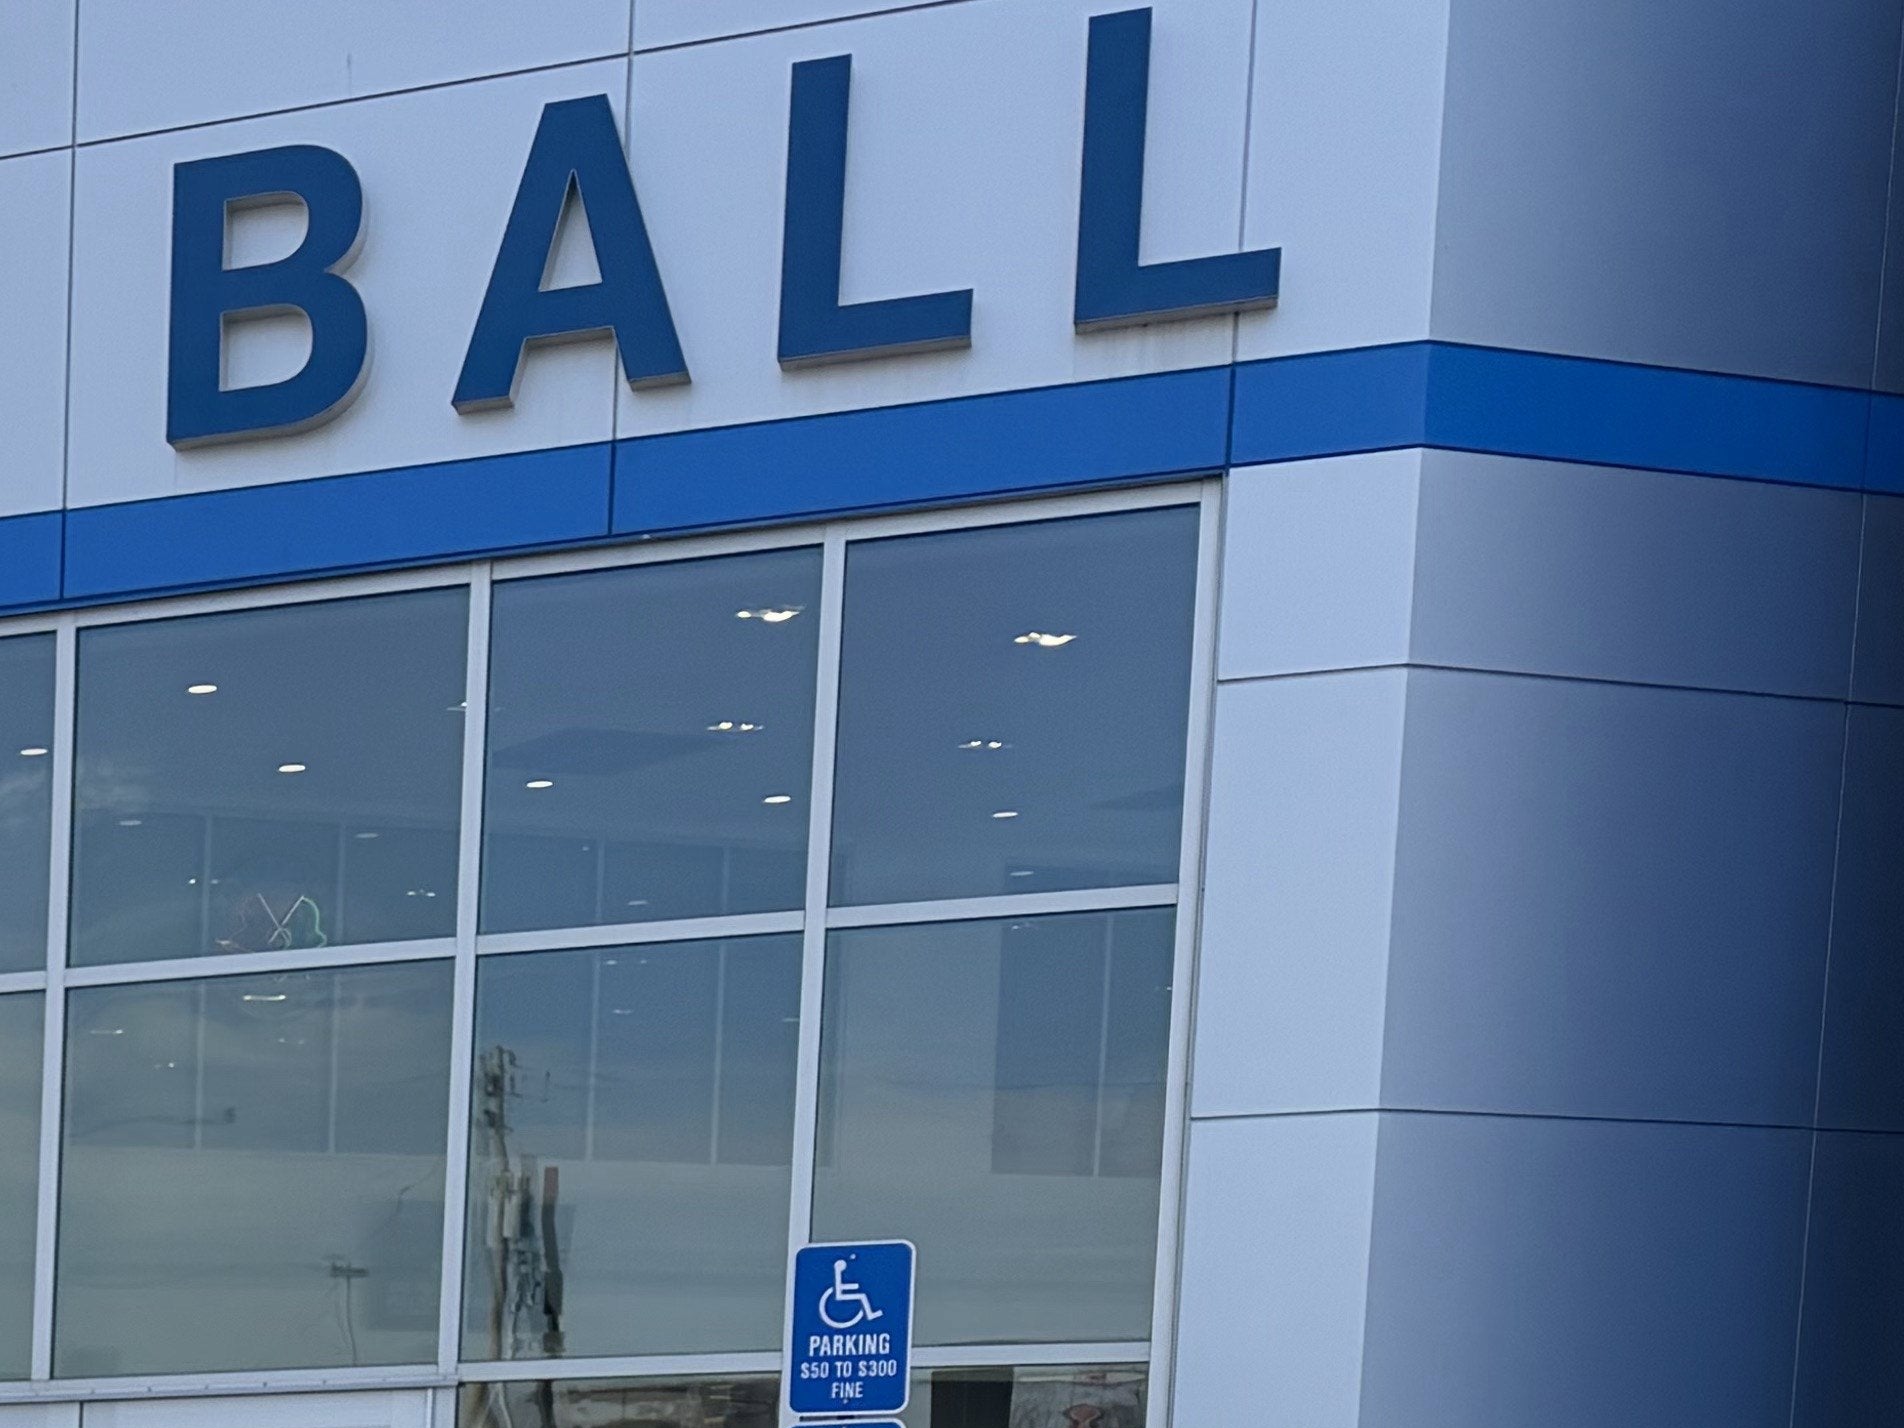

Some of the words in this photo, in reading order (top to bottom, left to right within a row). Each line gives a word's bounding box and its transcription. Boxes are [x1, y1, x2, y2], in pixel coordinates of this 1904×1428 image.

[166, 6, 1283, 450] BALL
[808, 1333, 891, 1357] PARKING
[800, 1361, 829, 1379] $50
[835, 1361, 853, 1377] TO
[858, 1359, 898, 1377] $300
[831, 1381, 864, 1399] FINE
